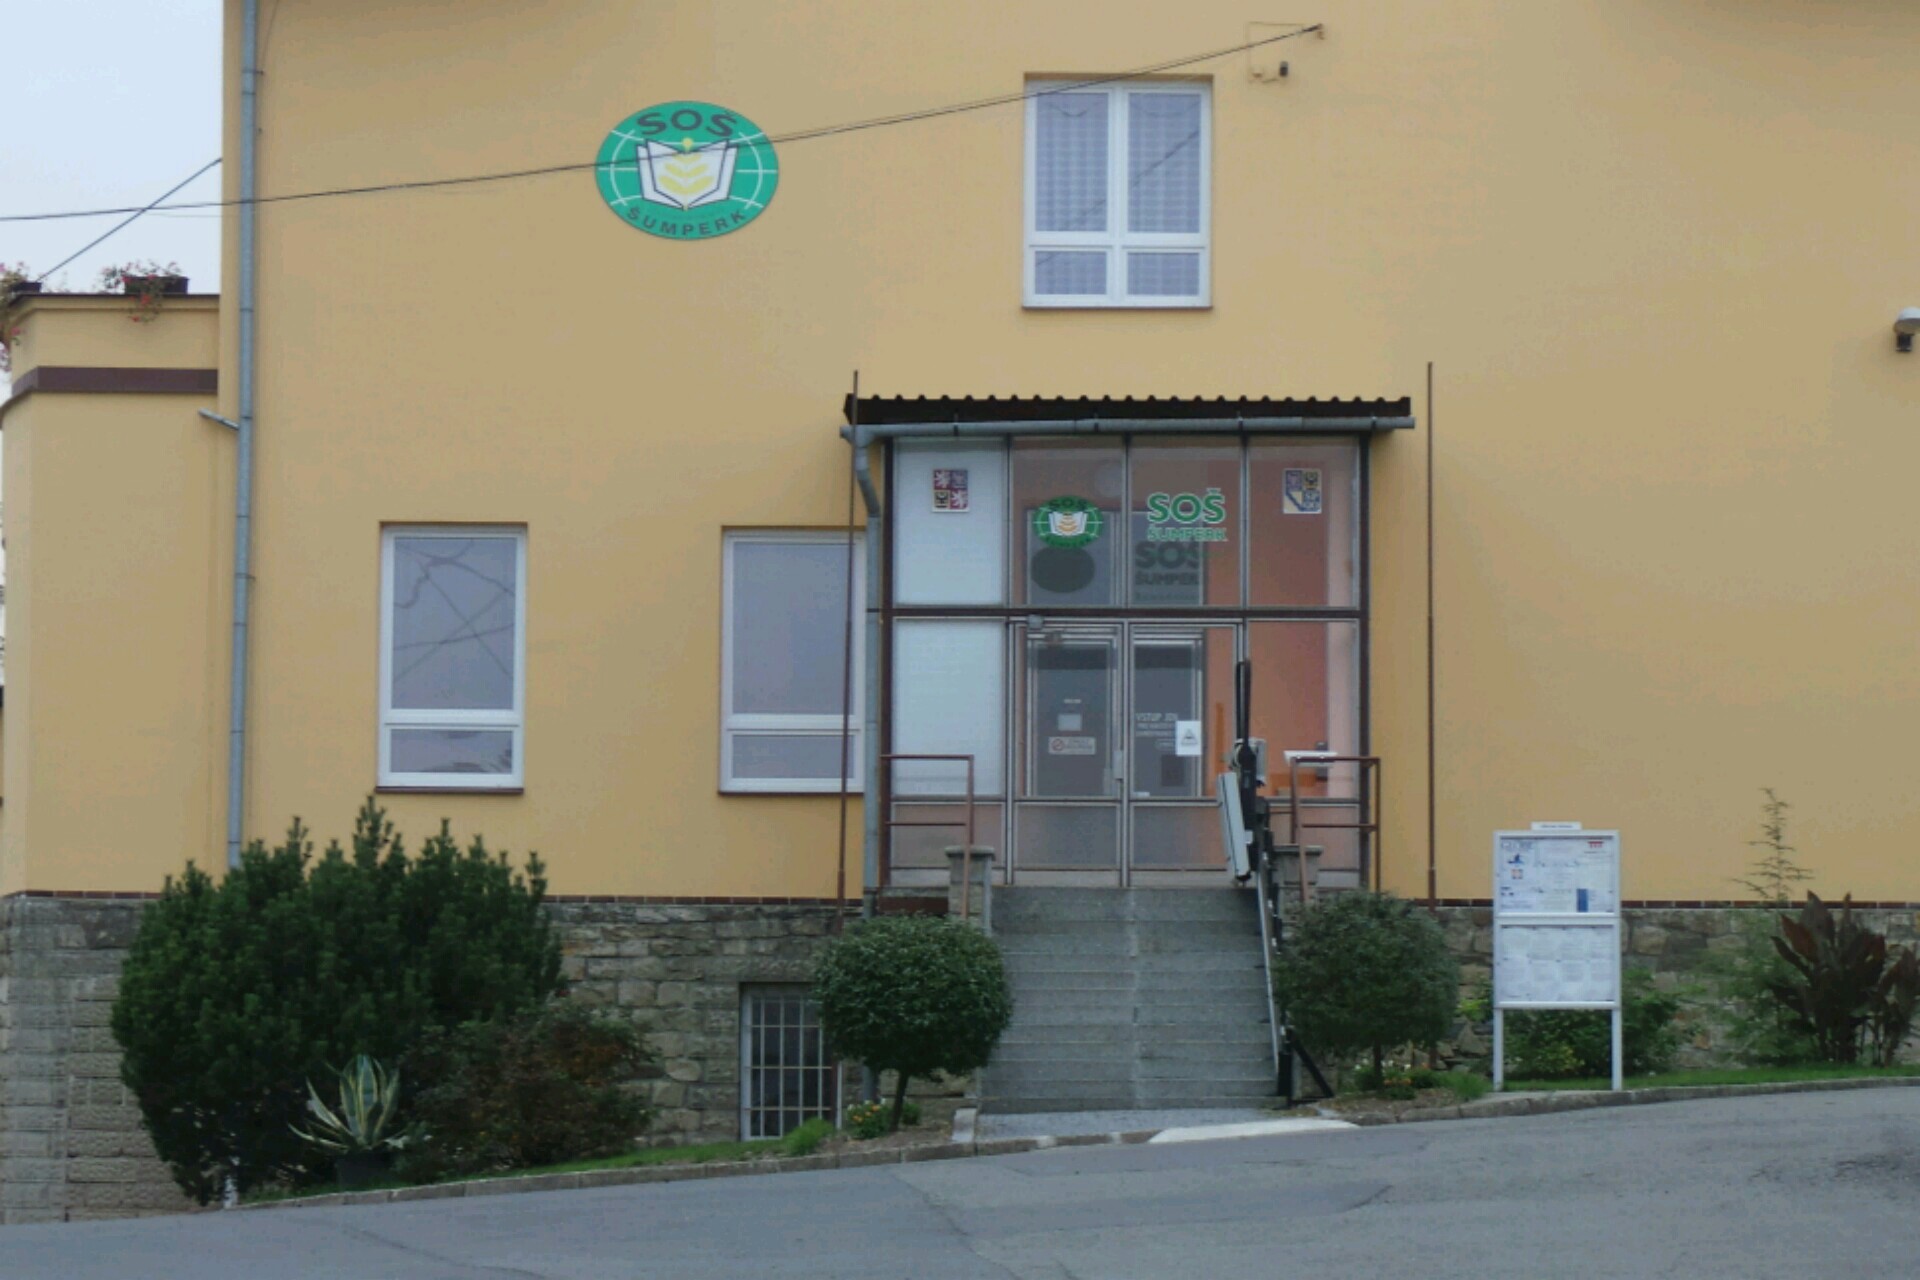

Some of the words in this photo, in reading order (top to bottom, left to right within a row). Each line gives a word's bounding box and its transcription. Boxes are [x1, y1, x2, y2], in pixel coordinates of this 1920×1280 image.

[636, 108, 738, 137] SOŠ
[626, 206, 747, 236] ŠUMPERK
[1147, 487, 1227, 525] SOŠ
[1147, 523, 1230, 542] ŠUMPERK
